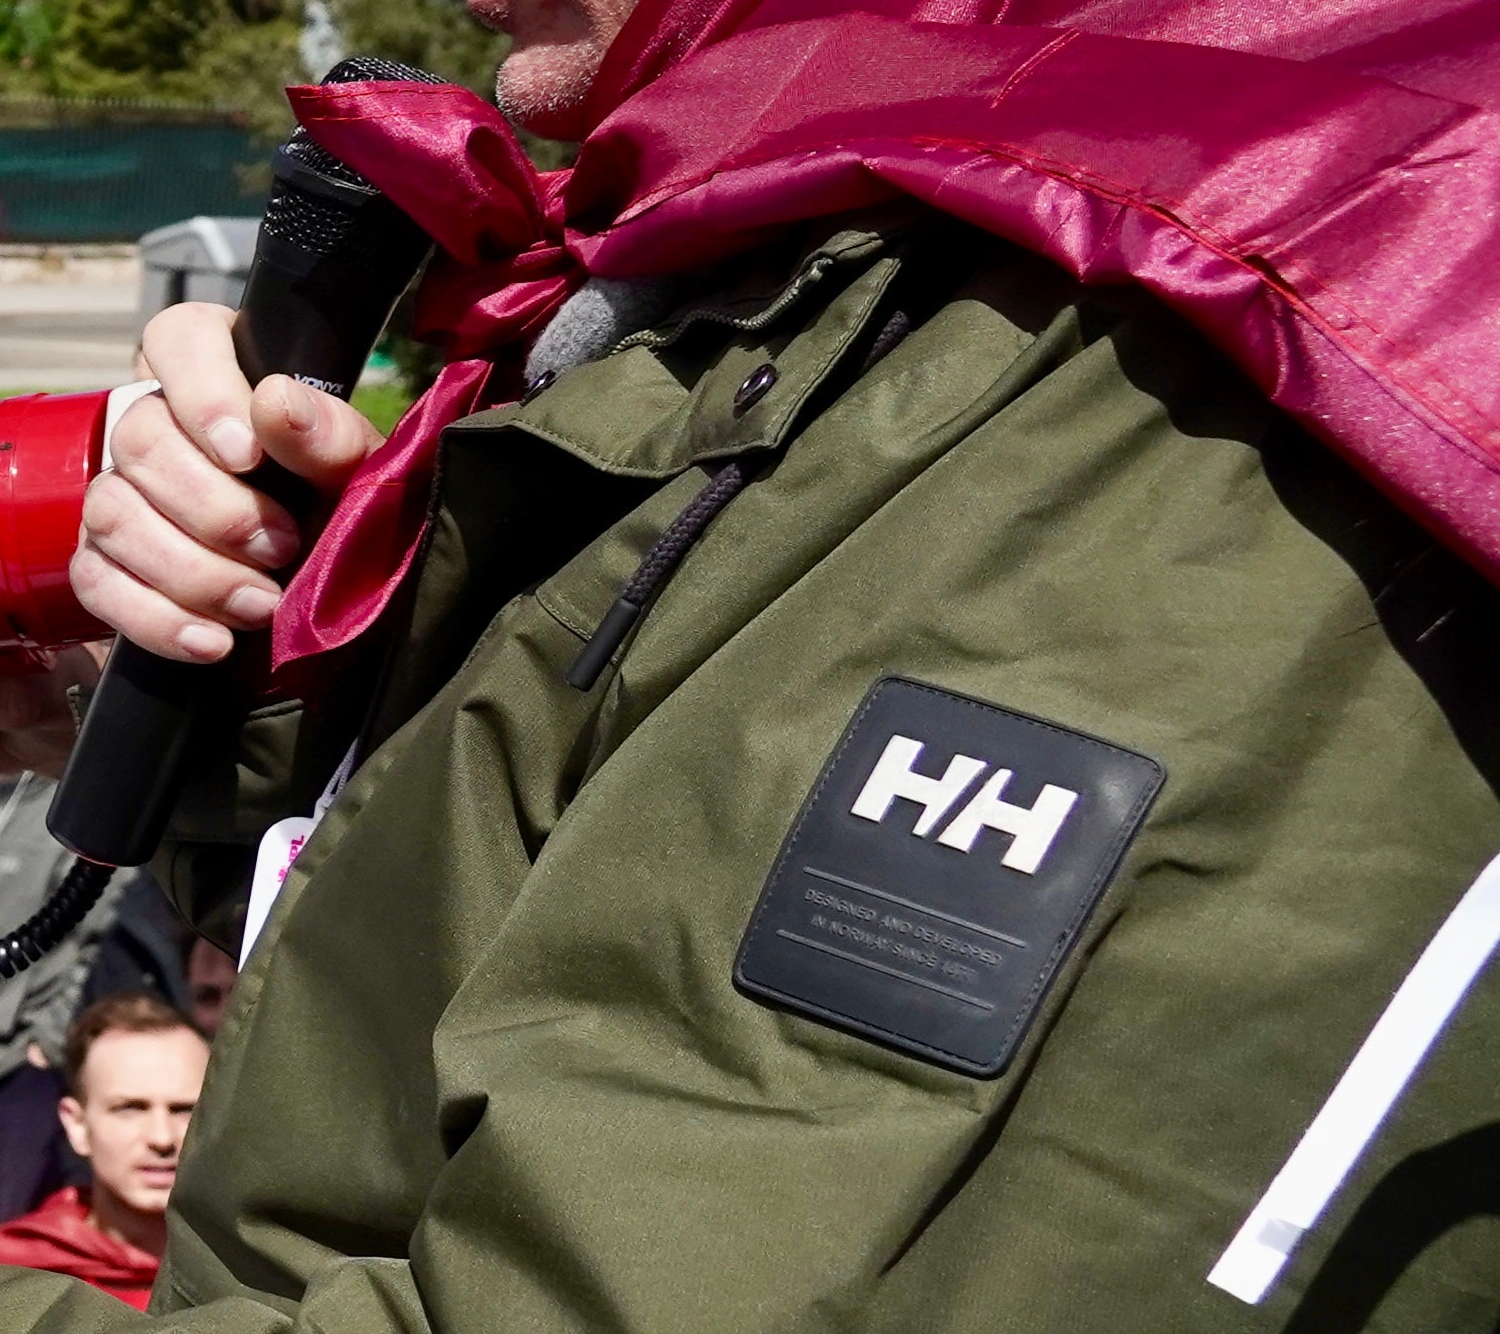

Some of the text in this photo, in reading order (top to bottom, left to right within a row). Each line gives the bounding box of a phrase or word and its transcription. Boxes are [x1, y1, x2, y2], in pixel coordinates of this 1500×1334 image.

[294, 373, 344, 394] VONYX
[804, 888, 1003, 967] DESIGNED AND DEVELOPED
[810, 914, 828, 928] IN
[830, 920, 891, 951] NORWAY
[892, 943, 939, 968] SINCE
